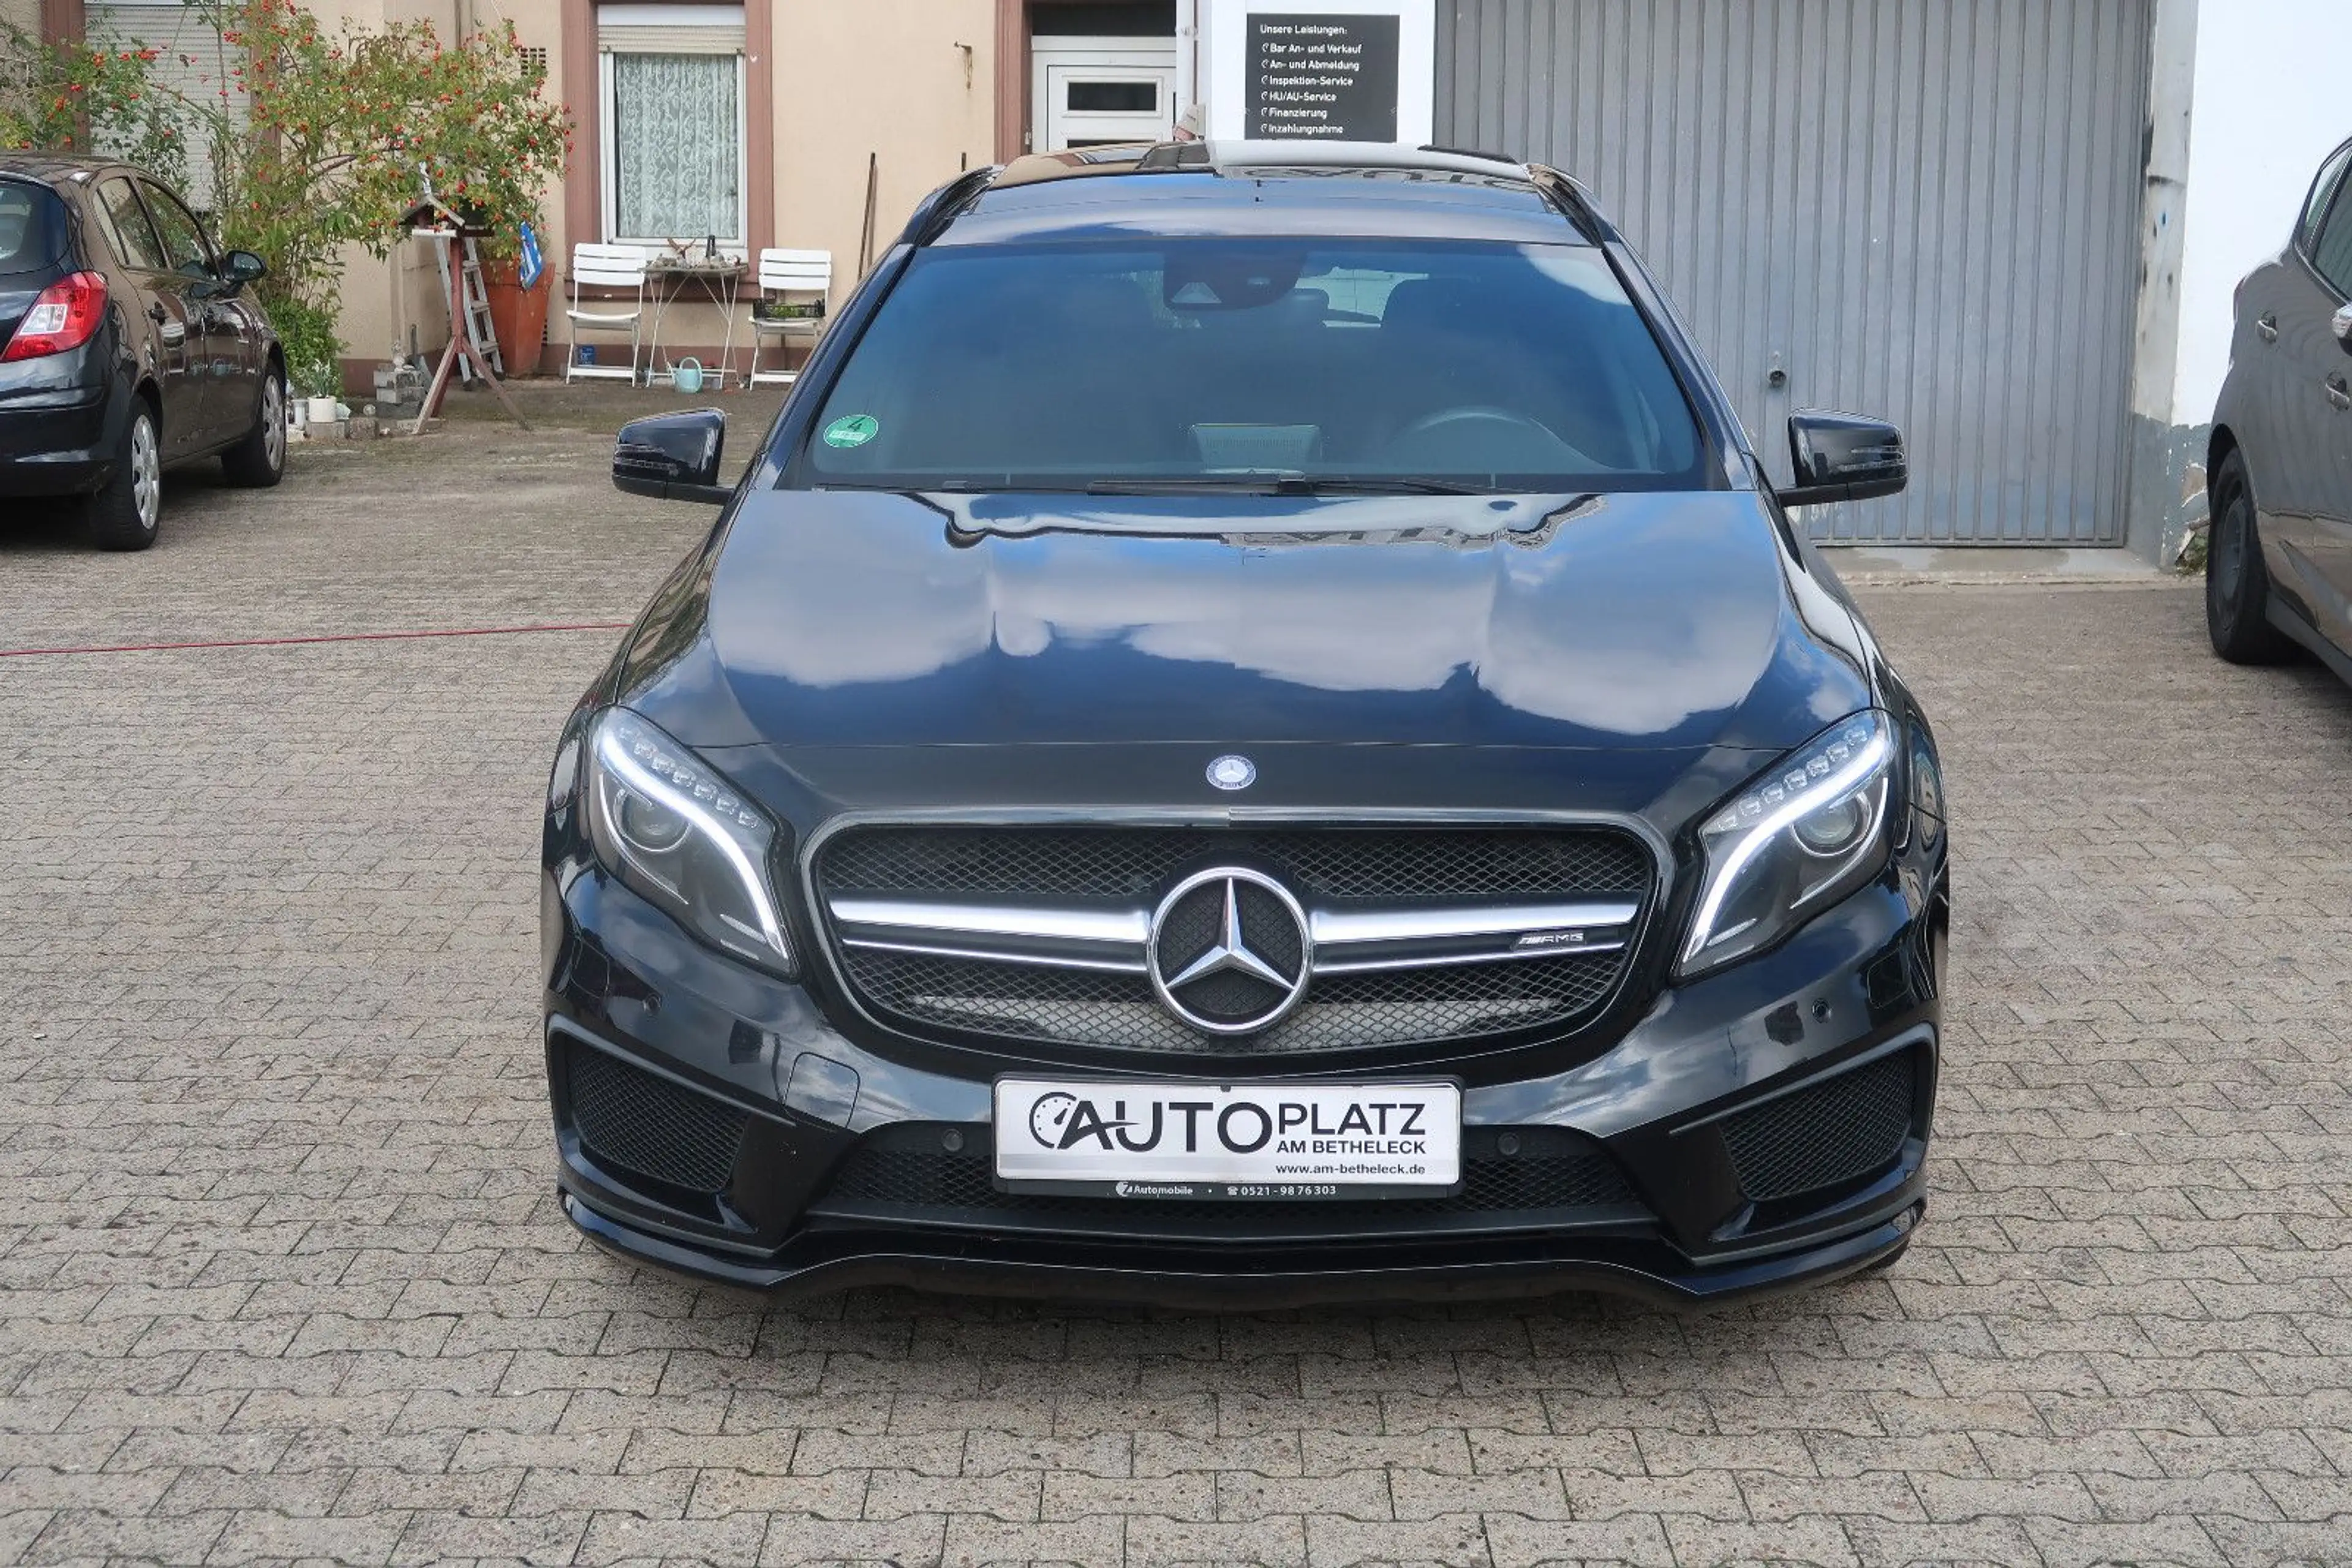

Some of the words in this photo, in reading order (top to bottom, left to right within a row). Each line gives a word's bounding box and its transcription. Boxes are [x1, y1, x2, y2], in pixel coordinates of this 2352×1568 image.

[1260, 24, 1292, 34] Unsere
[1295, 25, 1348, 37] Leistungen:
[1270, 43, 1287, 53] Bar
[1289, 44, 1305, 53] An-
[1308, 44, 1325, 53] und
[1327, 43, 1362, 54] Verkauf
[1270, 60, 1287, 69] An-
[1289, 59, 1306, 69] und
[1308, 60, 1359, 72] Abmeldung
[1269, 75, 1354, 86] Inspektion-Service
[1269, 91, 1337, 102] HU/AU-Service
[1268, 107, 1327, 119] Finanzierung
[1268, 124, 1344, 135] Inzahlungnahme
[1276, 1140, 1306, 1153] AM
[1312, 1140, 1426, 1155] BETHELECK
[1276, 1163, 1426, 1175] www.am-betheleck.de
[1134, 1185, 1193, 1195] Automobile
